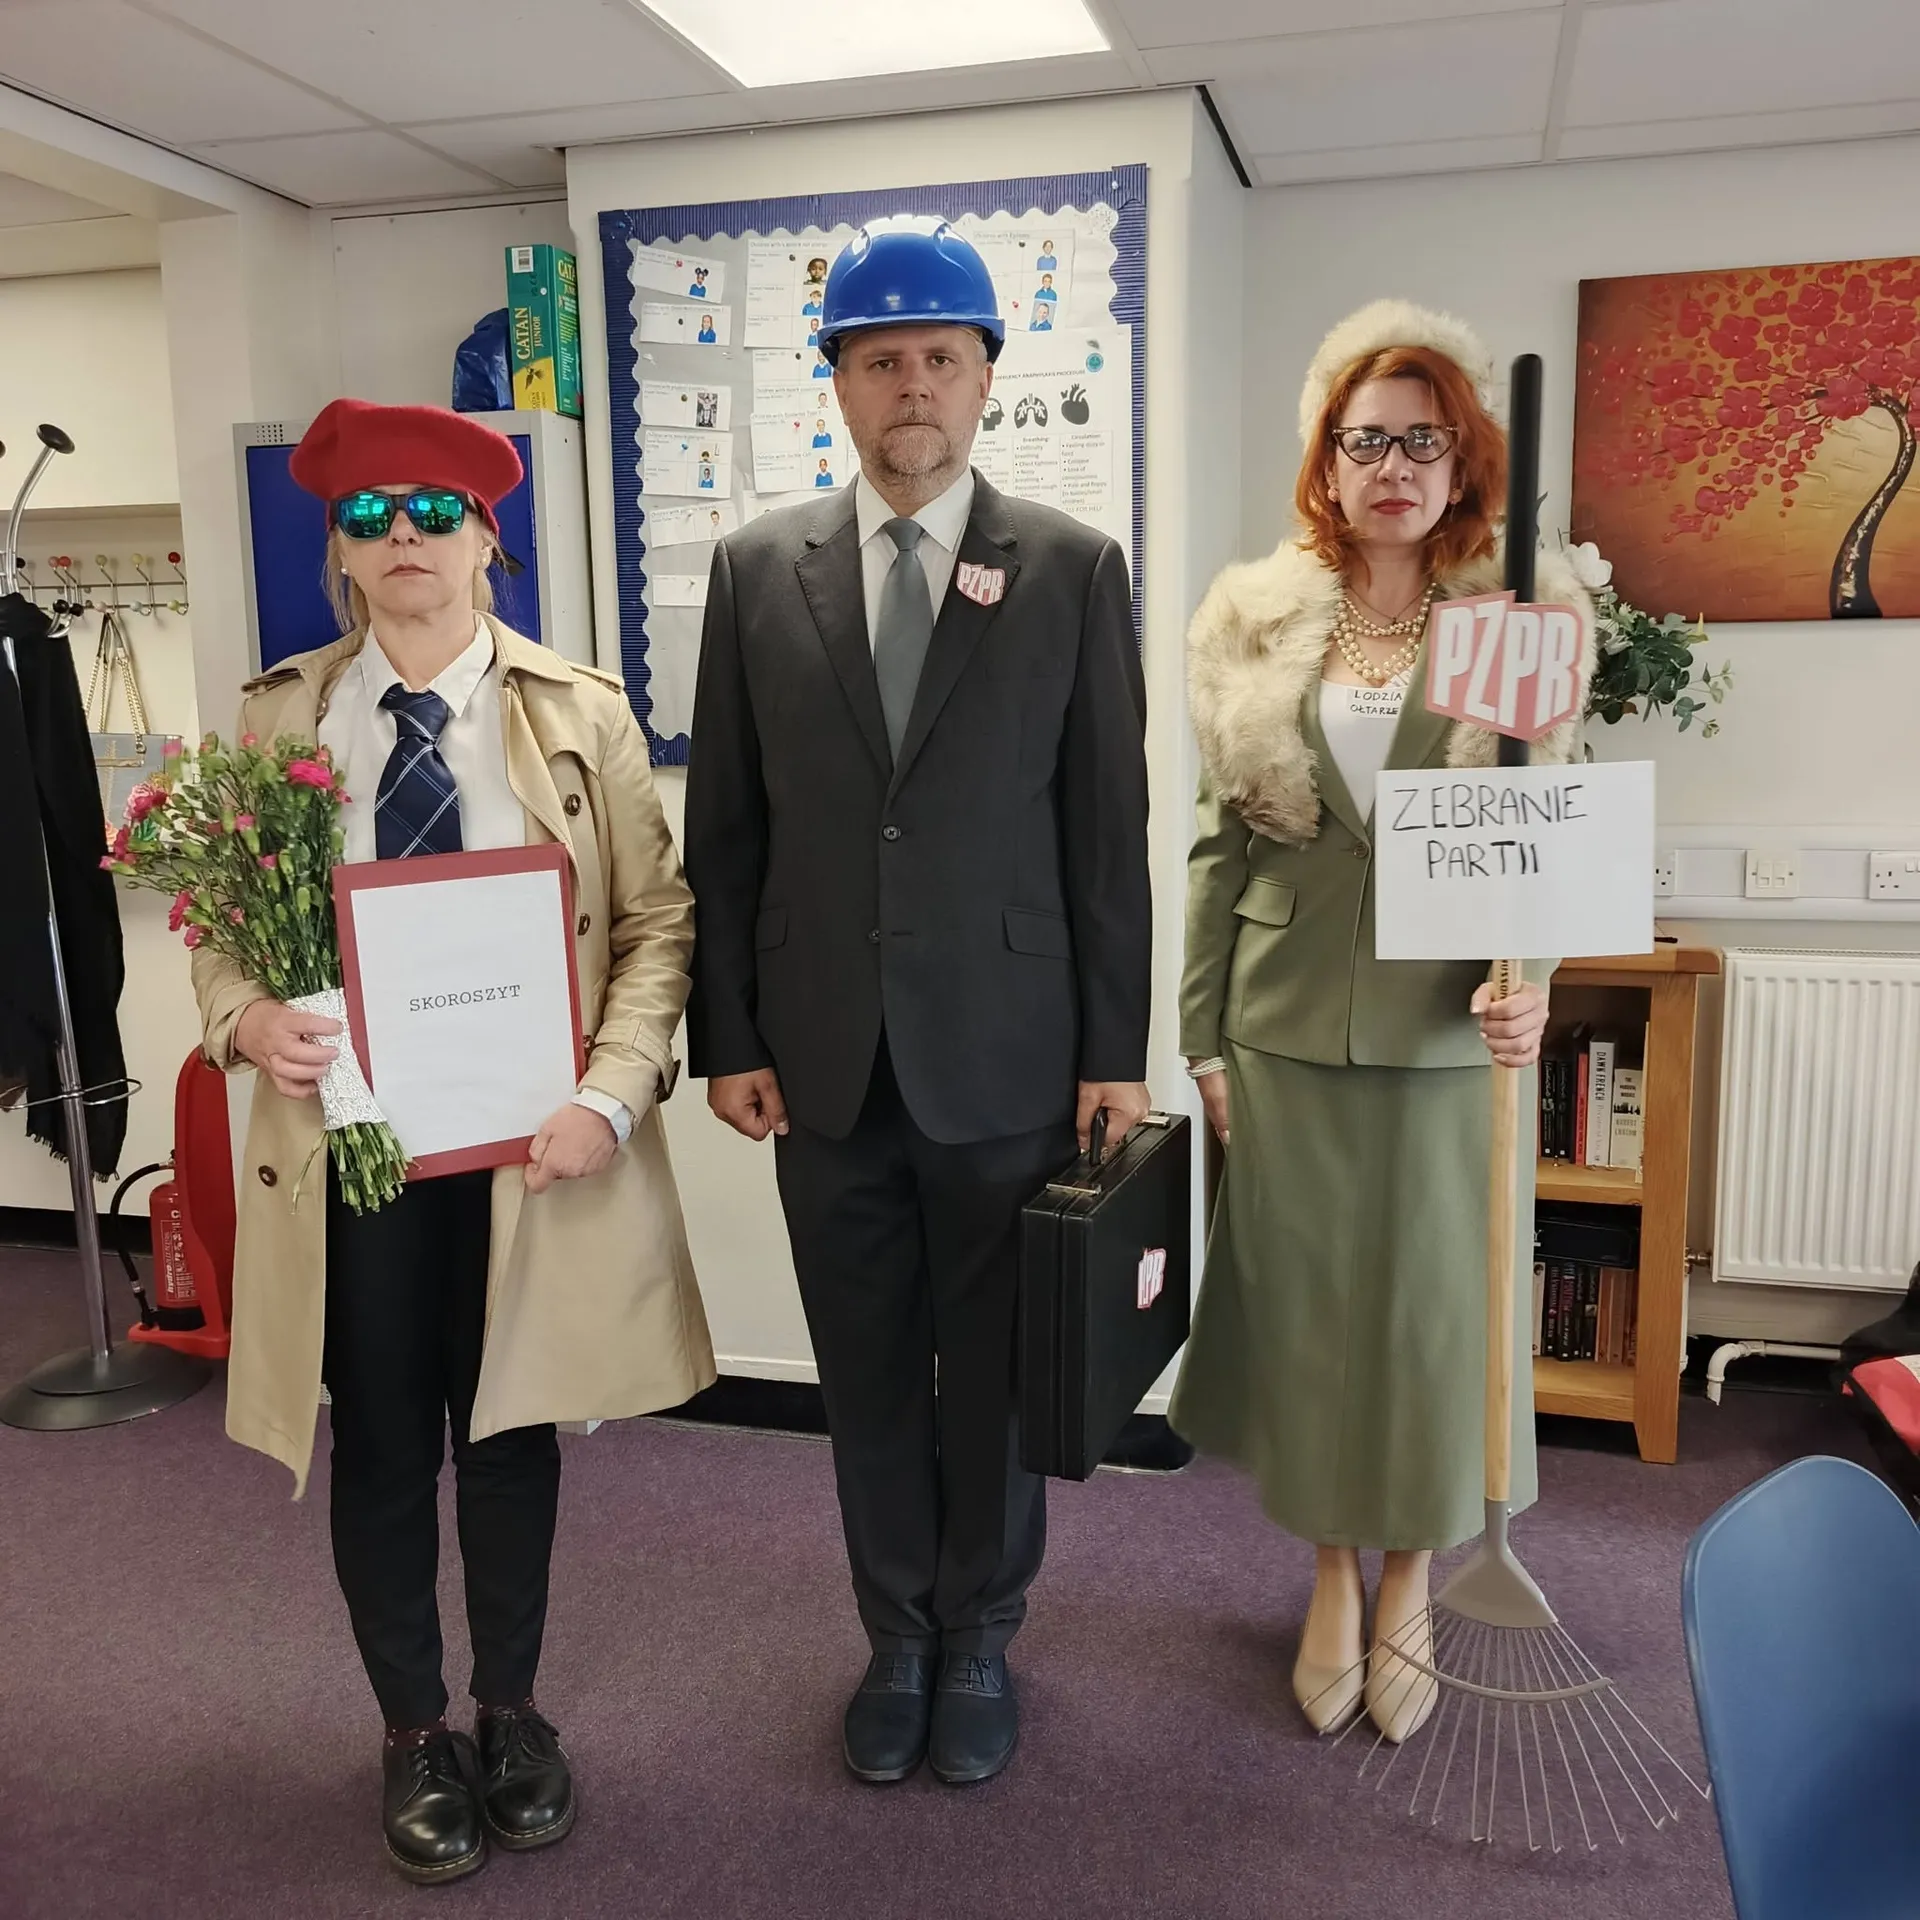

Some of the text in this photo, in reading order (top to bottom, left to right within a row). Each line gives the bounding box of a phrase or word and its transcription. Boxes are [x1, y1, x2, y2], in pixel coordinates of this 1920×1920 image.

[514, 307, 531, 360] CATAN
[533, 316, 544, 348] JUNIOR
[960, 564, 1003, 604] PZPR
[1432, 600, 1579, 729] PZPR
[1392, 784, 1588, 831] ZEBRANIE
[1427, 840, 1540, 879] PARTII
[409, 984, 521, 1013] SKOROSZYT
[1596, 1051, 1607, 1073] DAWN
[1595, 1074, 1606, 1101] FRENCH
